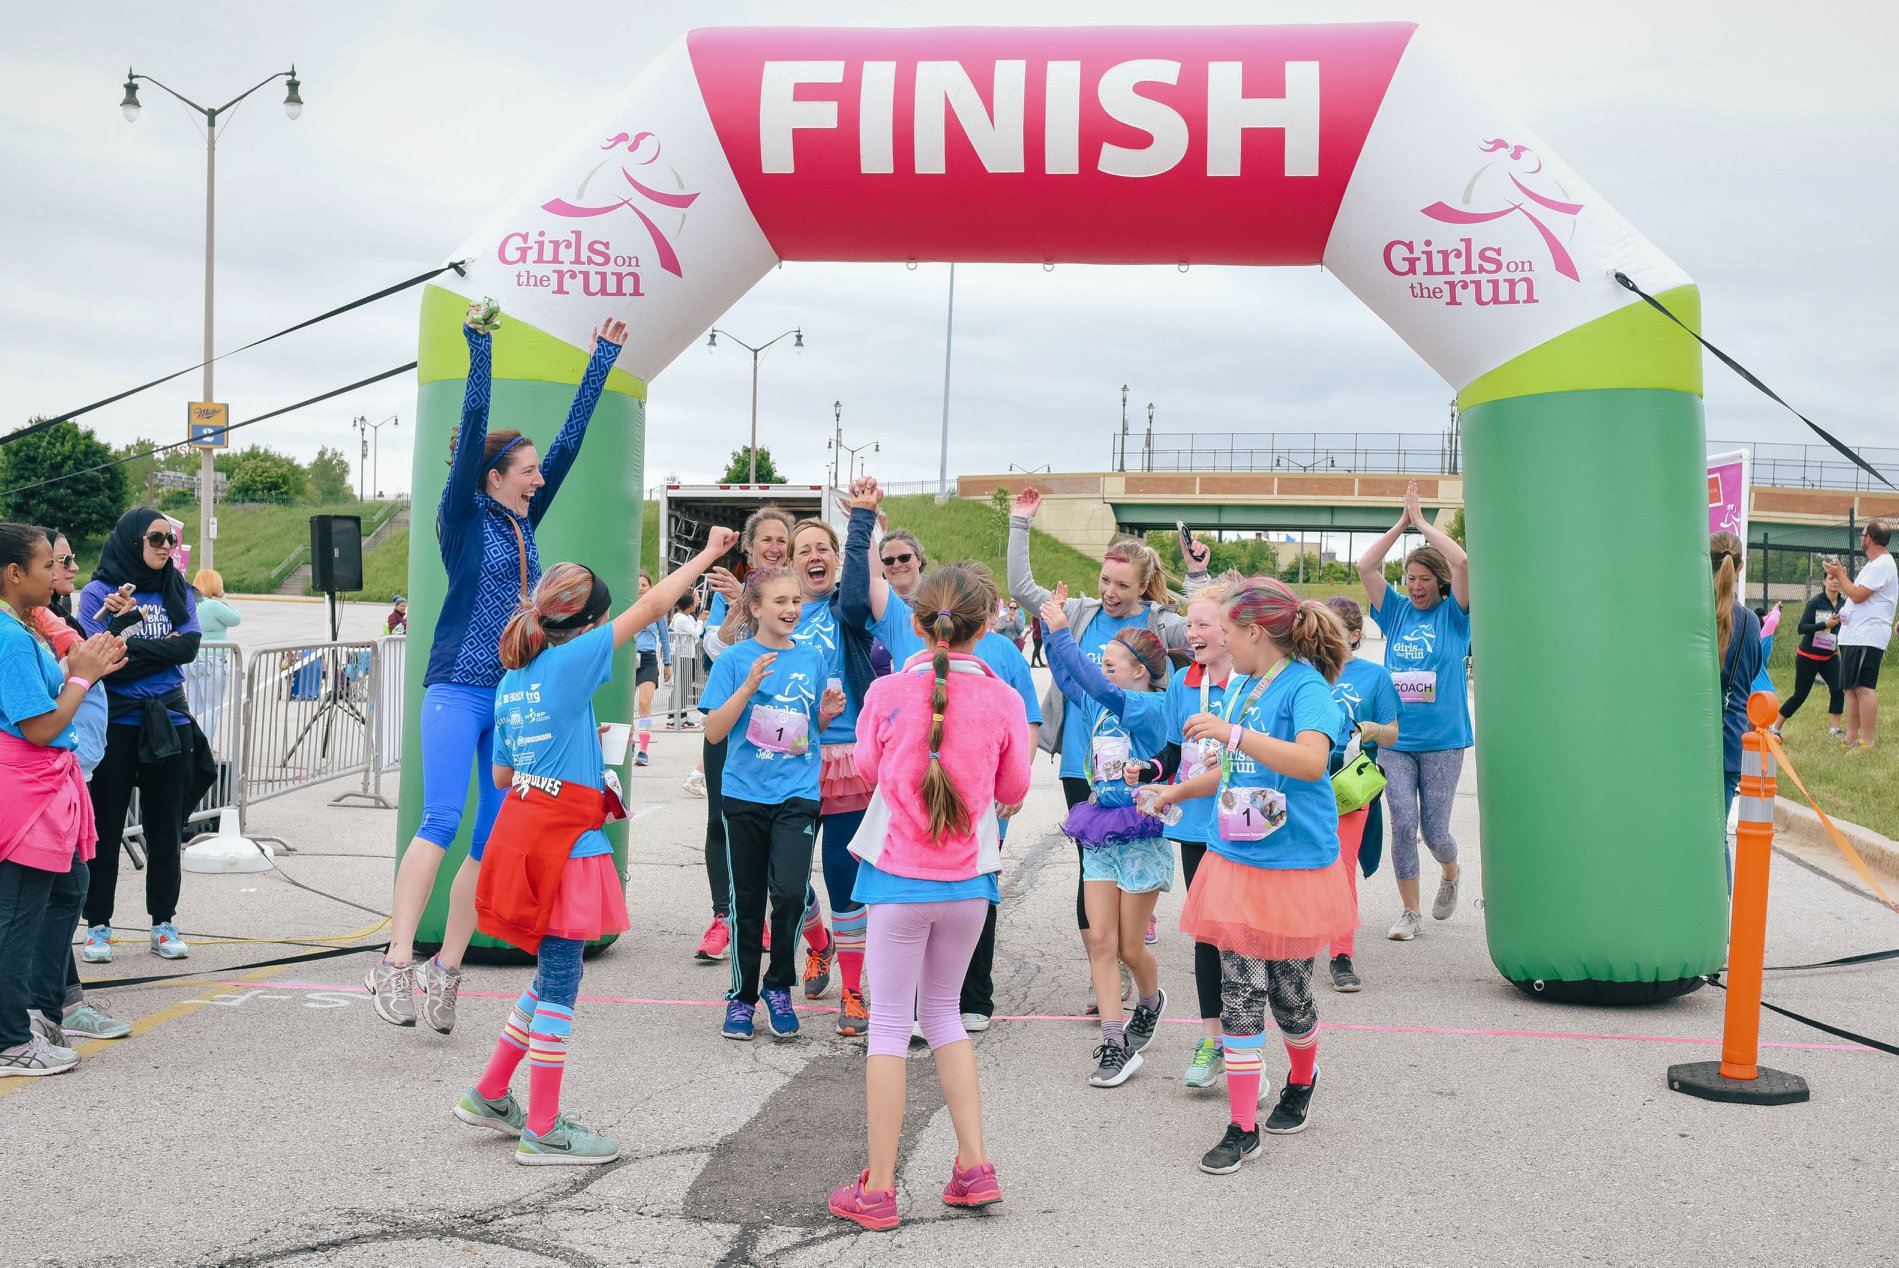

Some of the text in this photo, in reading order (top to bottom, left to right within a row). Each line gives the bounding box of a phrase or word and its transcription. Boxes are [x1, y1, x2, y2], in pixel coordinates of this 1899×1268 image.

[760, 58, 1320, 178] FINISH
[497, 229, 641, 268] Girls on
[1383, 237, 1535, 277] Girls on
[515, 268, 645, 297] the run
[1408, 276, 1540, 306] the run
[202, 427, 215, 442] 2
[775, 727, 784, 742] 1
[1093, 753, 1099, 770] 1
[1230, 761, 1257, 774] run
[1242, 807, 1251, 827] 1
